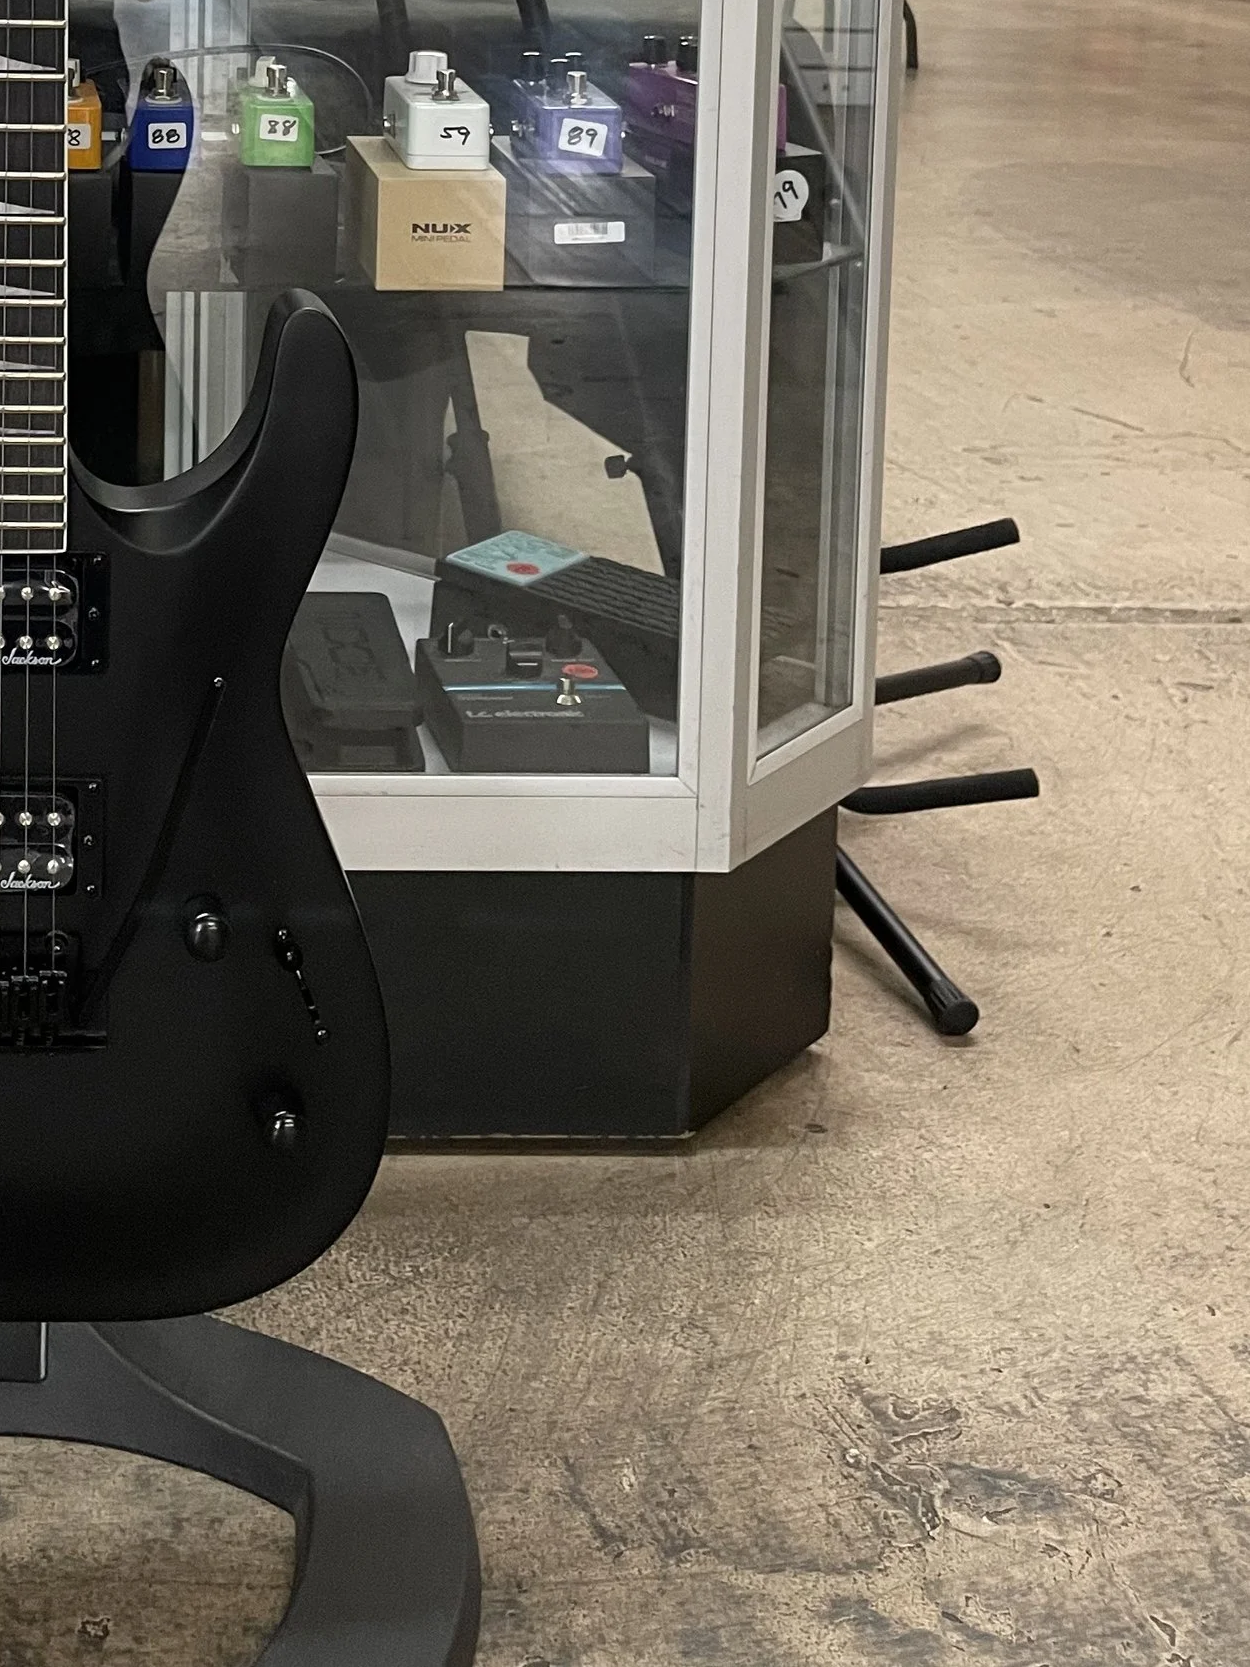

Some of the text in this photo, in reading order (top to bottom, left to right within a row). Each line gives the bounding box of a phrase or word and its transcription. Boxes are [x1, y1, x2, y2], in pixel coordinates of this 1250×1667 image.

[439, 126, 471, 146] 59
[567, 125, 599, 149] 89
[411, 223, 472, 234] NUX
[2, 647, 62, 665] Jackson
[0, 872, 60, 890] Jackson
